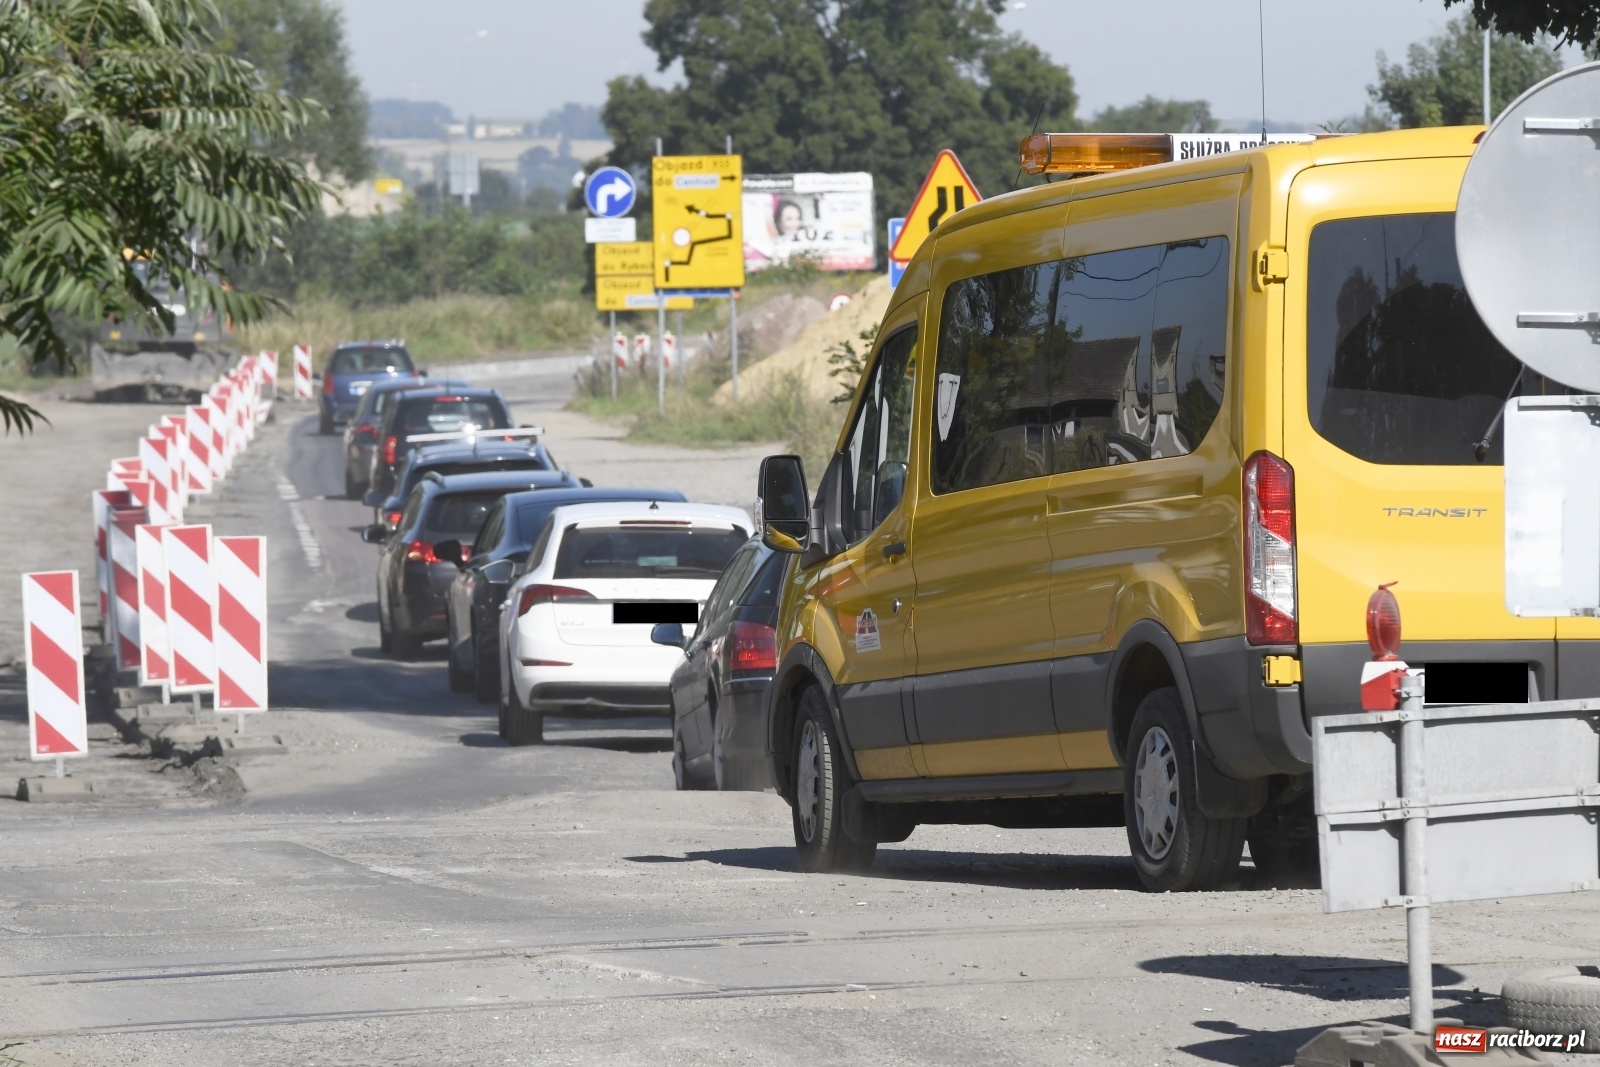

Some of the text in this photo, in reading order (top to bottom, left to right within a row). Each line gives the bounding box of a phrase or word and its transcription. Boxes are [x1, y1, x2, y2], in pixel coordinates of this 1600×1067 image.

[1180, 138, 1231, 160] SŁUŻBA
[654, 159, 704, 173] Objazd
[655, 174, 718, 187] do Centrum
[1382, 507, 1488, 518] TRANSIT
